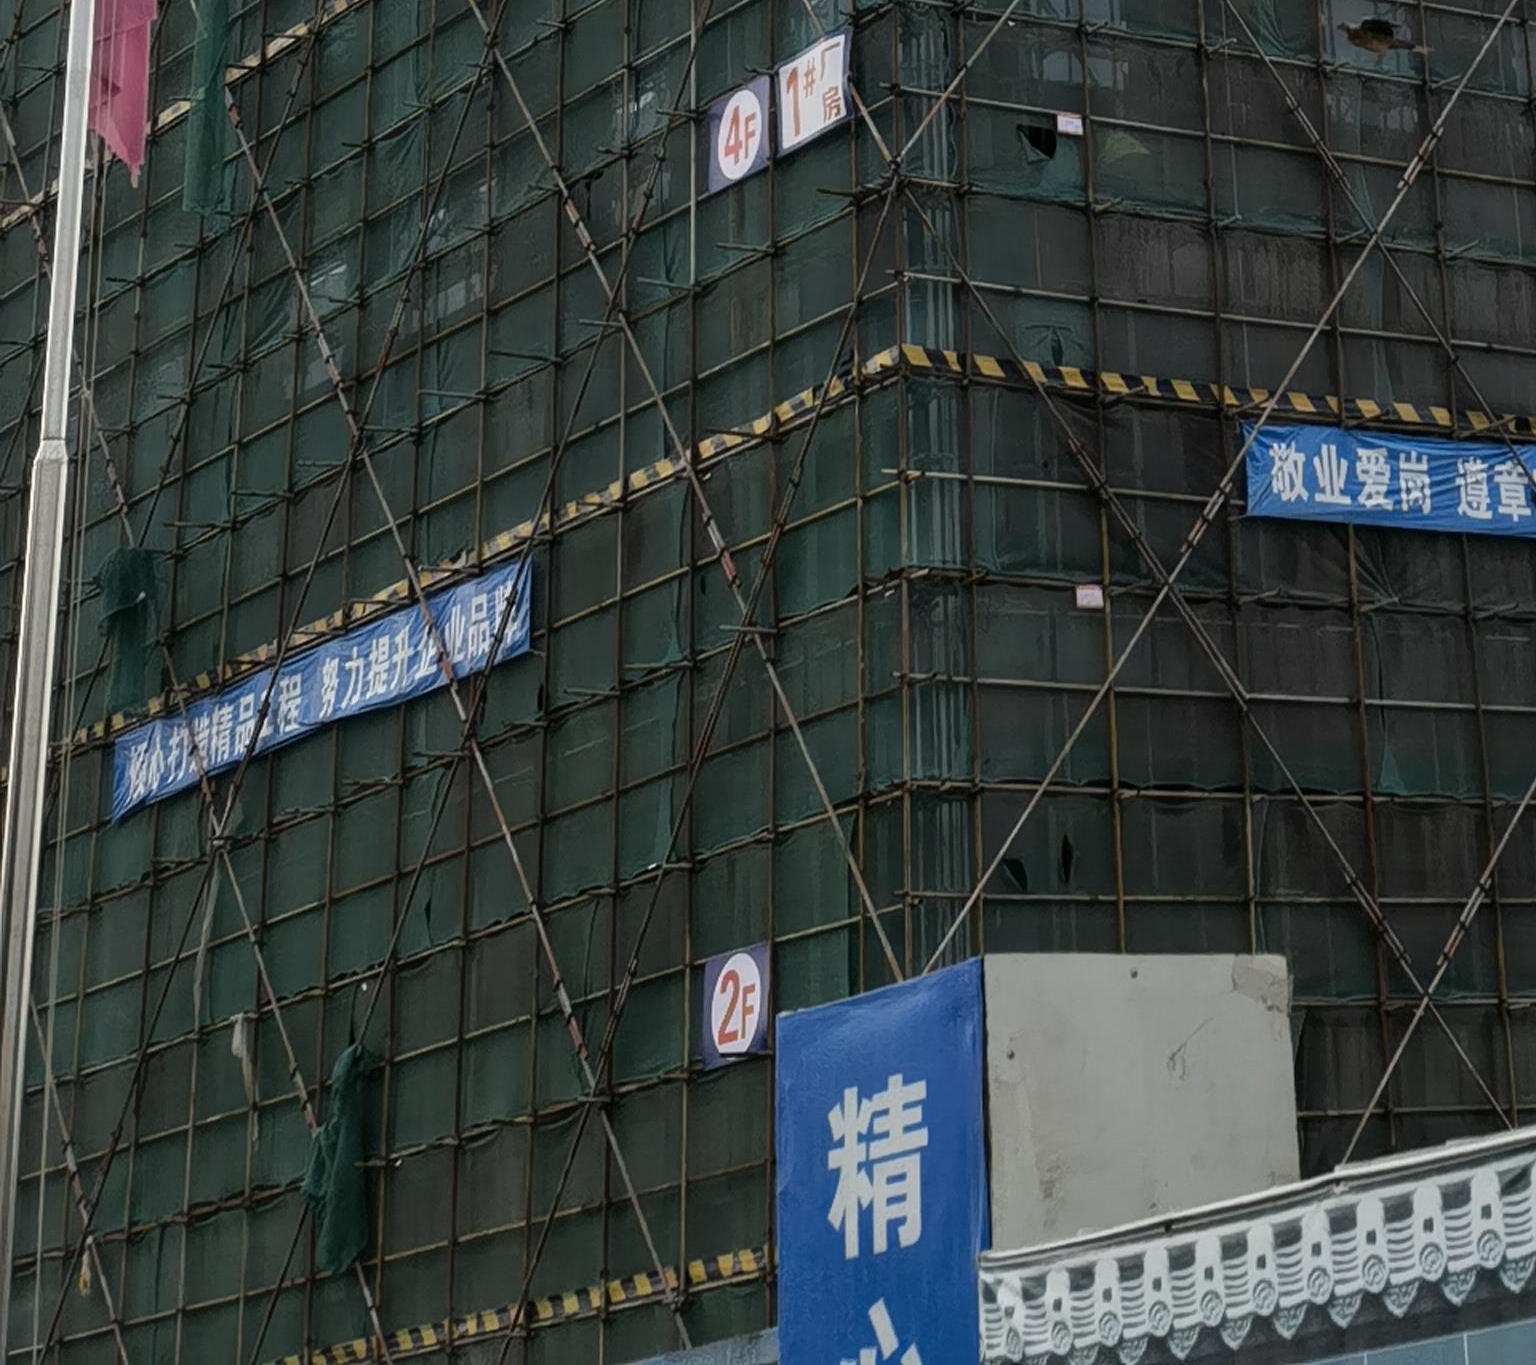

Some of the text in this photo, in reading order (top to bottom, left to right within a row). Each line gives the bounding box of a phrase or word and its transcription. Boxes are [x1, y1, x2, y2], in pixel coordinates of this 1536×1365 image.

[723, 105, 757, 166] 4F
[1268, 441, 1433, 515] 敬业爱岗
[717, 968, 757, 1046] 2F
